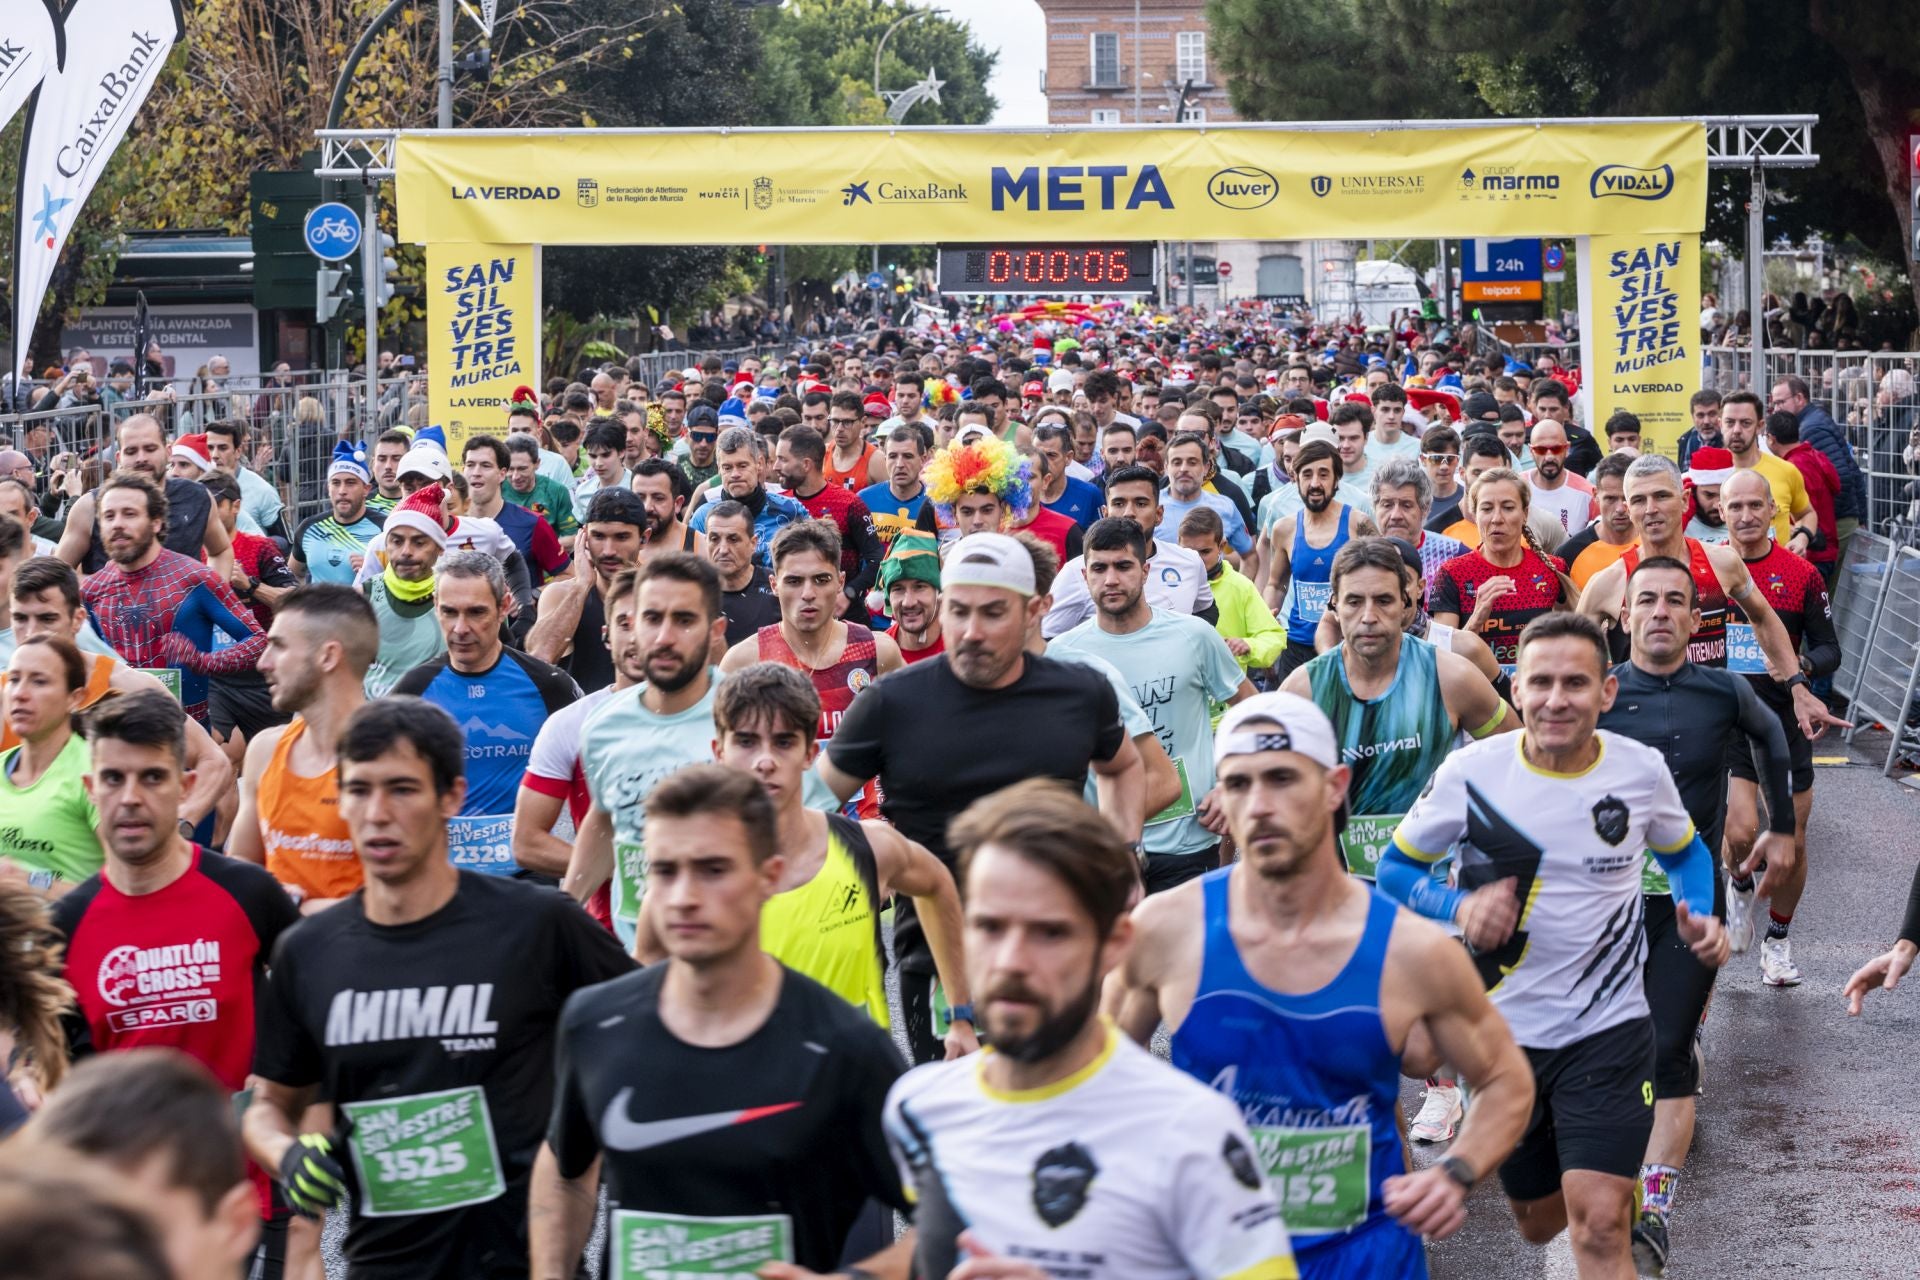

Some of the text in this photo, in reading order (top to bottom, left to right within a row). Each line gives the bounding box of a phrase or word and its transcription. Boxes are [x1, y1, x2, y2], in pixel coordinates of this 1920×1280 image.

[57, 31, 160, 178] CaixaBank
[606, 186, 688, 194] Federación de Atletismo
[778, 188, 829, 196] Ayuntamiento
[878, 182, 968, 200] CaixaBank
[991, 164, 1175, 210] META
[1215, 181, 1270, 197] Juver
[1342, 176, 1424, 187] UNIVERSAE
[1483, 175, 1559, 190] marmo
[1602, 175, 1663, 190] VIDAL
[452, 186, 560, 200] LA VERDAD
[624, 195, 644, 203] Región
[989, 251, 1128, 282] 0:00:06
[1495, 258, 1524, 272] 24h
[1609, 241, 1681, 278] SAN
[445, 257, 515, 293] SAN
[1482, 285, 1522, 297] telpark
[1619, 271, 1670, 303] SIL
[456, 286, 505, 318] SIL
[1613, 293, 1678, 330] VES
[70, 318, 232, 331] IMPLANTOLGÍA AVANZADA
[450, 309, 513, 344] VES
[92, 331, 207, 345] Y ESTÉTA DENTAL
[1614, 321, 1681, 357] TRE
[450, 336, 515, 370] TRE
[1614, 346, 1685, 374] MURCIA
[450, 361, 521, 388] MURCIA
[1613, 383, 1683, 394] LA VERDAD
[450, 397, 512, 408] LA VERDA
[1301, 589, 1331, 600] SILVES
[1481, 617, 1512, 633] PL
[1727, 628, 1744, 637] AN
[1686, 638, 1725, 664] NTRENADOR
[463, 743, 531, 760] COTRAIL
[1348, 820, 1376, 833] SAN
[1348, 824, 1399, 846] SILVES
[453, 843, 511, 865] 2328
[135, 938, 220, 971] DUATLÓN
[137, 965, 202, 995] CROSS
[121, 1005, 188, 1027] SPAR
[325, 983, 499, 1047] ANIMAL
[440, 1036, 497, 1052] TEAM
[357, 1107, 399, 1136] SAN
[359, 1094, 476, 1156] SILVESTRE
[374, 1141, 467, 1182] 3525
